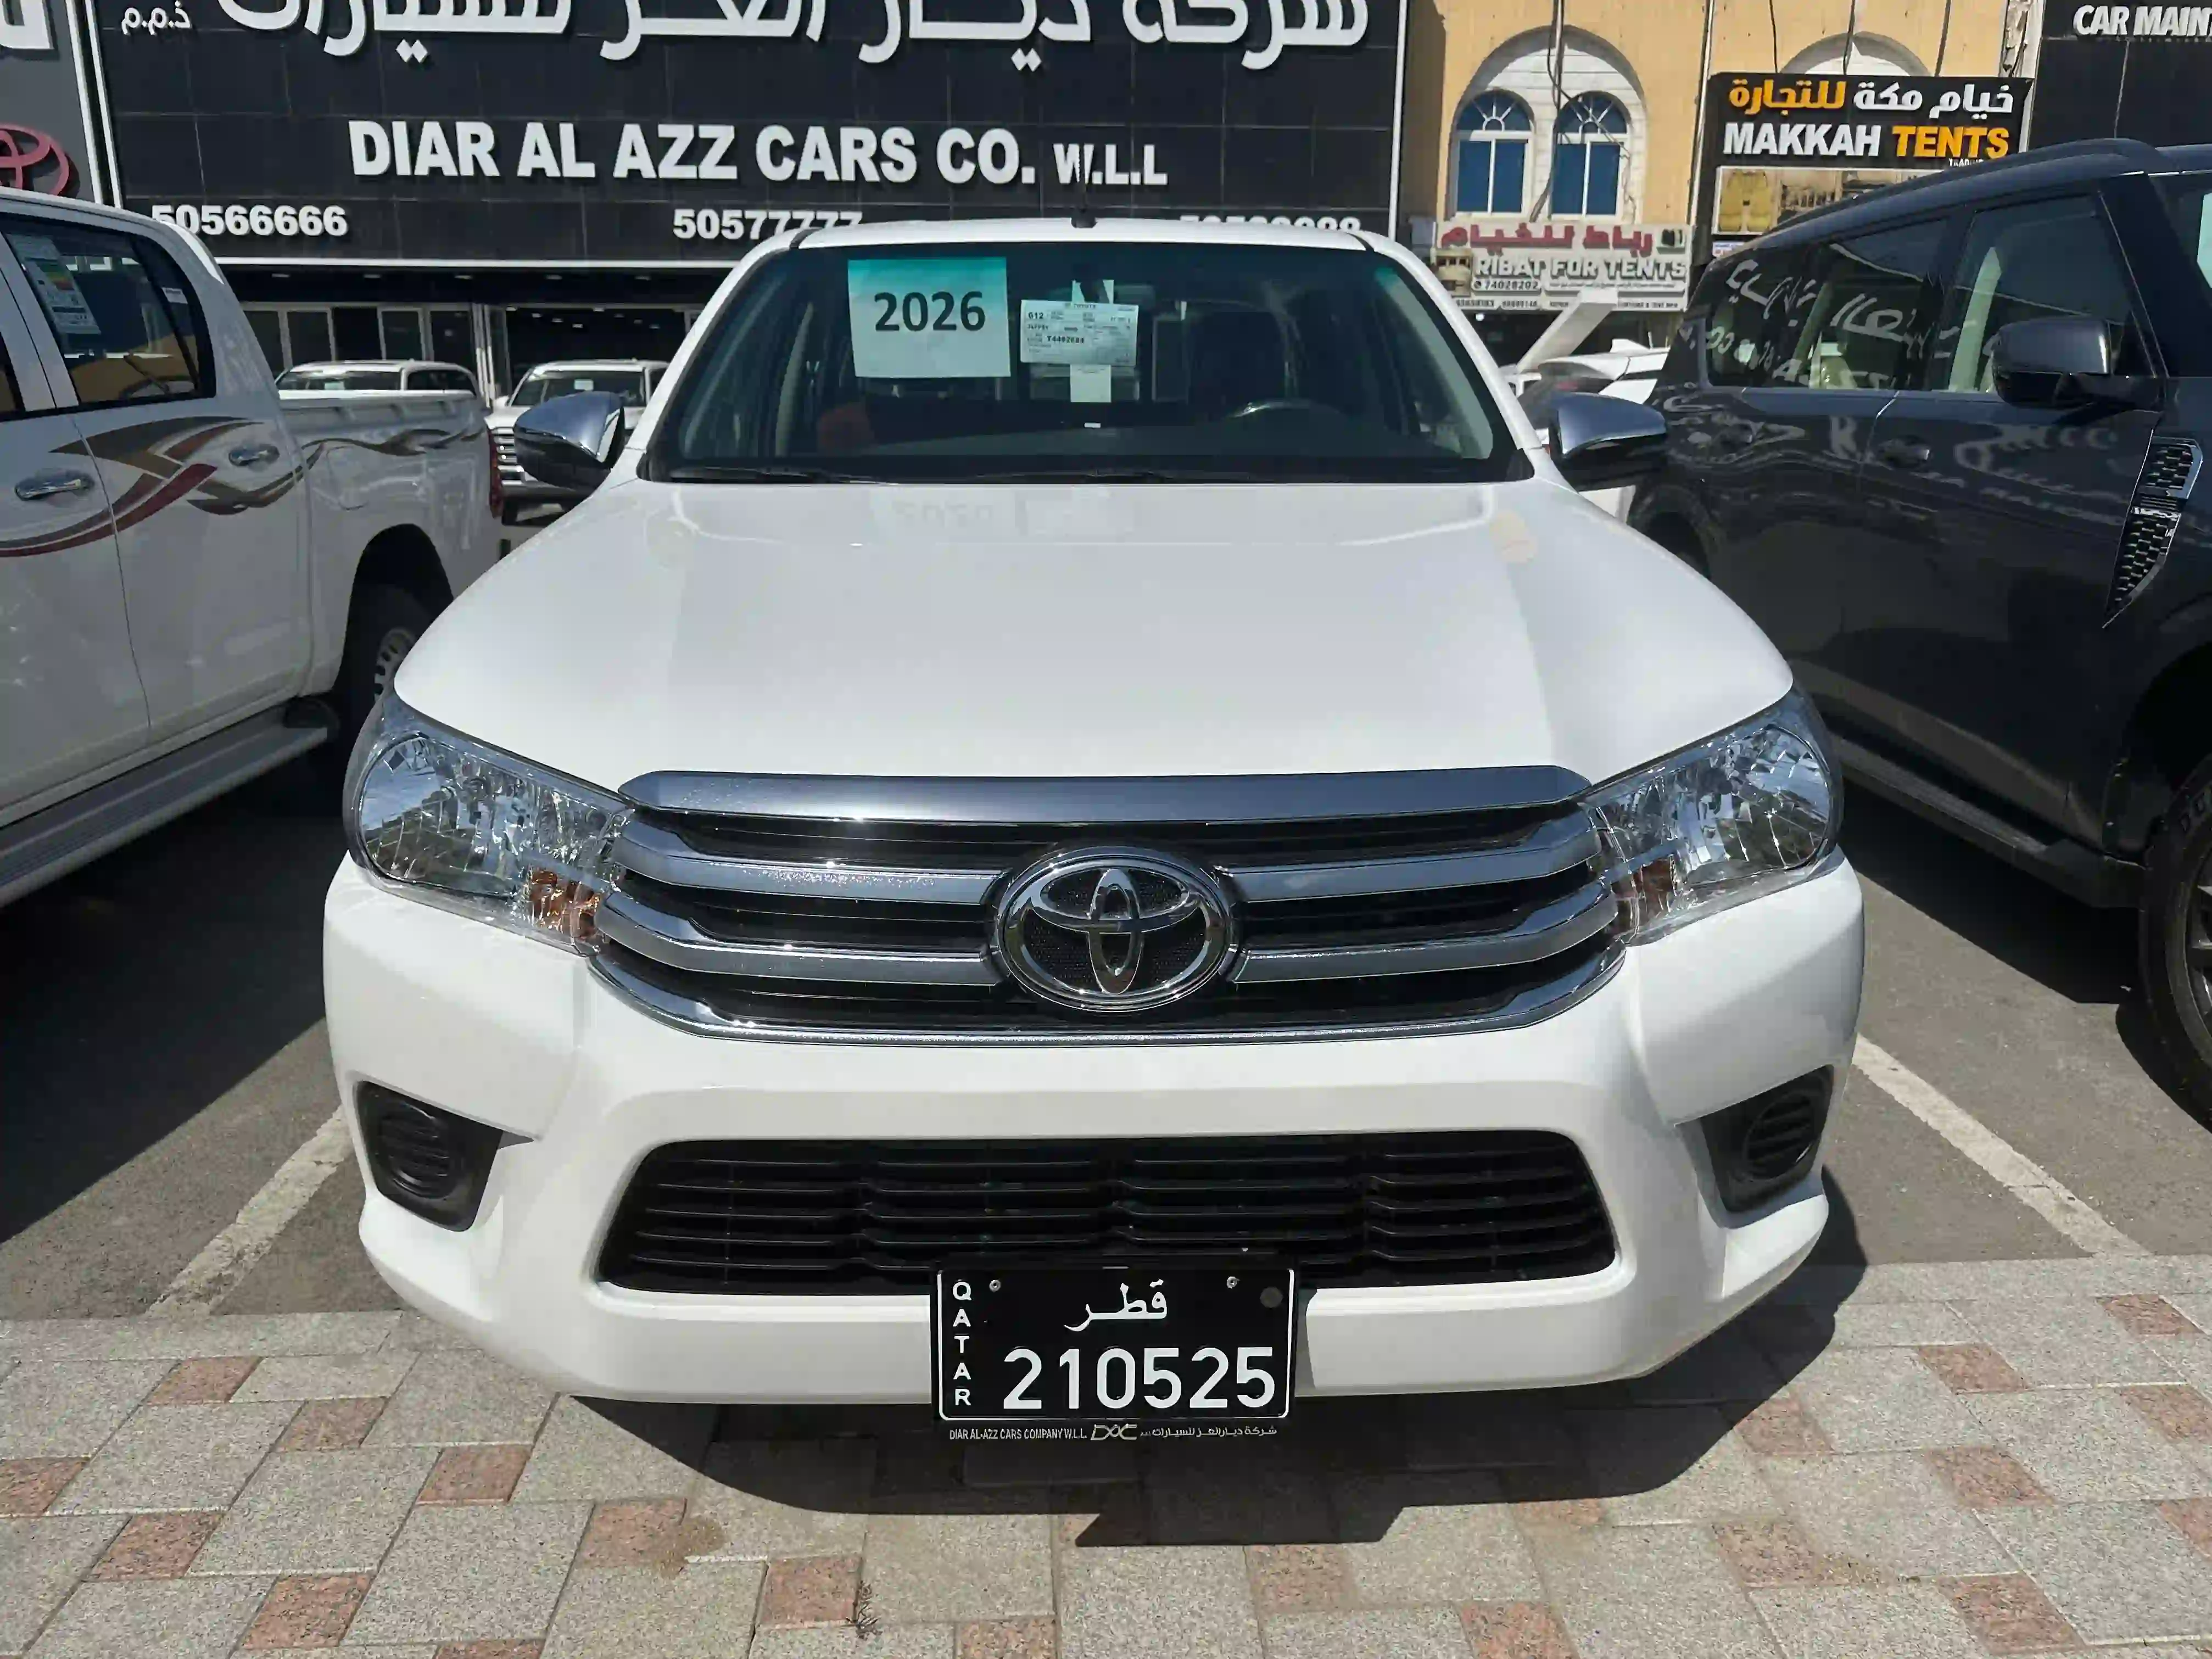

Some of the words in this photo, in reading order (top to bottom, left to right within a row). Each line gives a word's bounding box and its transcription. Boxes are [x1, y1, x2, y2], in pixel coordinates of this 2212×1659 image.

[2074, 5, 2130, 35] CAR
[2133, 6, 2212, 36] MAIN
[1729, 79, 1846, 115] للتجارة
[1853, 82, 1923, 110] مكة
[1929, 84, 2013, 120] خيام
[349, 120, 500, 176] DIAR
[517, 122, 596, 178] AL
[613, 124, 738, 179] AZZ
[756, 125, 917, 183] CARS
[937, 128, 1035, 183] CO.
[1723, 122, 1881, 157] MAKKAH
[1892, 125, 2009, 159] TENTS
[152, 205, 348, 236] 50566666
[1440, 222, 1575, 256] للخيام
[1583, 225, 1654, 258] رباط
[1476, 257, 1545, 278] RIBAT
[1550, 257, 1600, 279] FOR
[1602, 257, 1687, 279] TENTS
[874, 291, 986, 331] 2026
[1064, 1278, 1168, 1332] قطر
[952, 1280, 972, 1406] QATAR
[1003, 1346, 1276, 1409] 210525
[949, 1428, 969, 1440] DIAR
[999, 1428, 1022, 1439] CARS
[1024, 1428, 1063, 1439] COMPANY
[1064, 1428, 1088, 1439] W.L.L.
[1219, 1427, 1243, 1438] ديار
[1244, 1426, 1278, 1437] شركة
